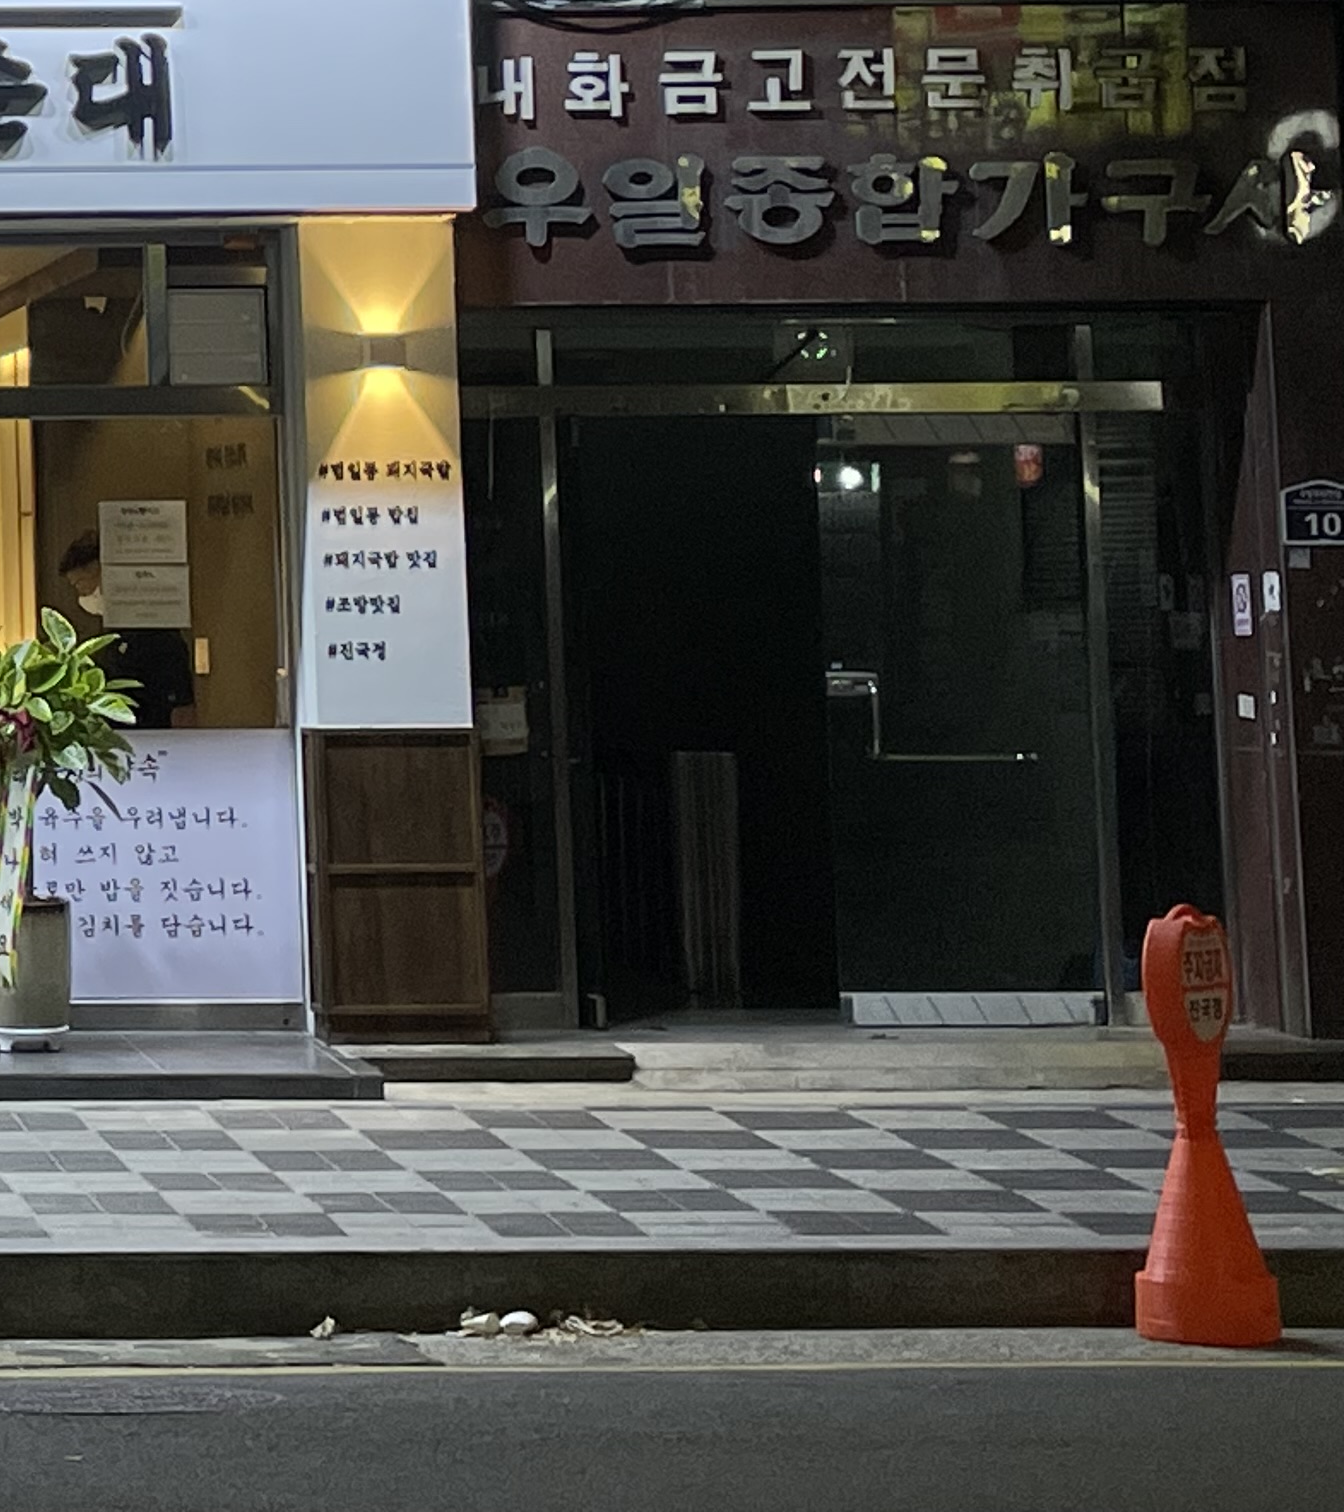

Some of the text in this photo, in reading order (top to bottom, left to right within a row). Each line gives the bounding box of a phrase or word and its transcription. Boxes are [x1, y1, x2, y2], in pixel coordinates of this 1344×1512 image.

[386, 460, 452, 482] 돼지국밥
[1304, 512, 1342, 536] 10
[74, 842, 118, 866] 쓰지
[134, 842, 180, 867] 않고
[99, 877, 145, 903] 밥을
